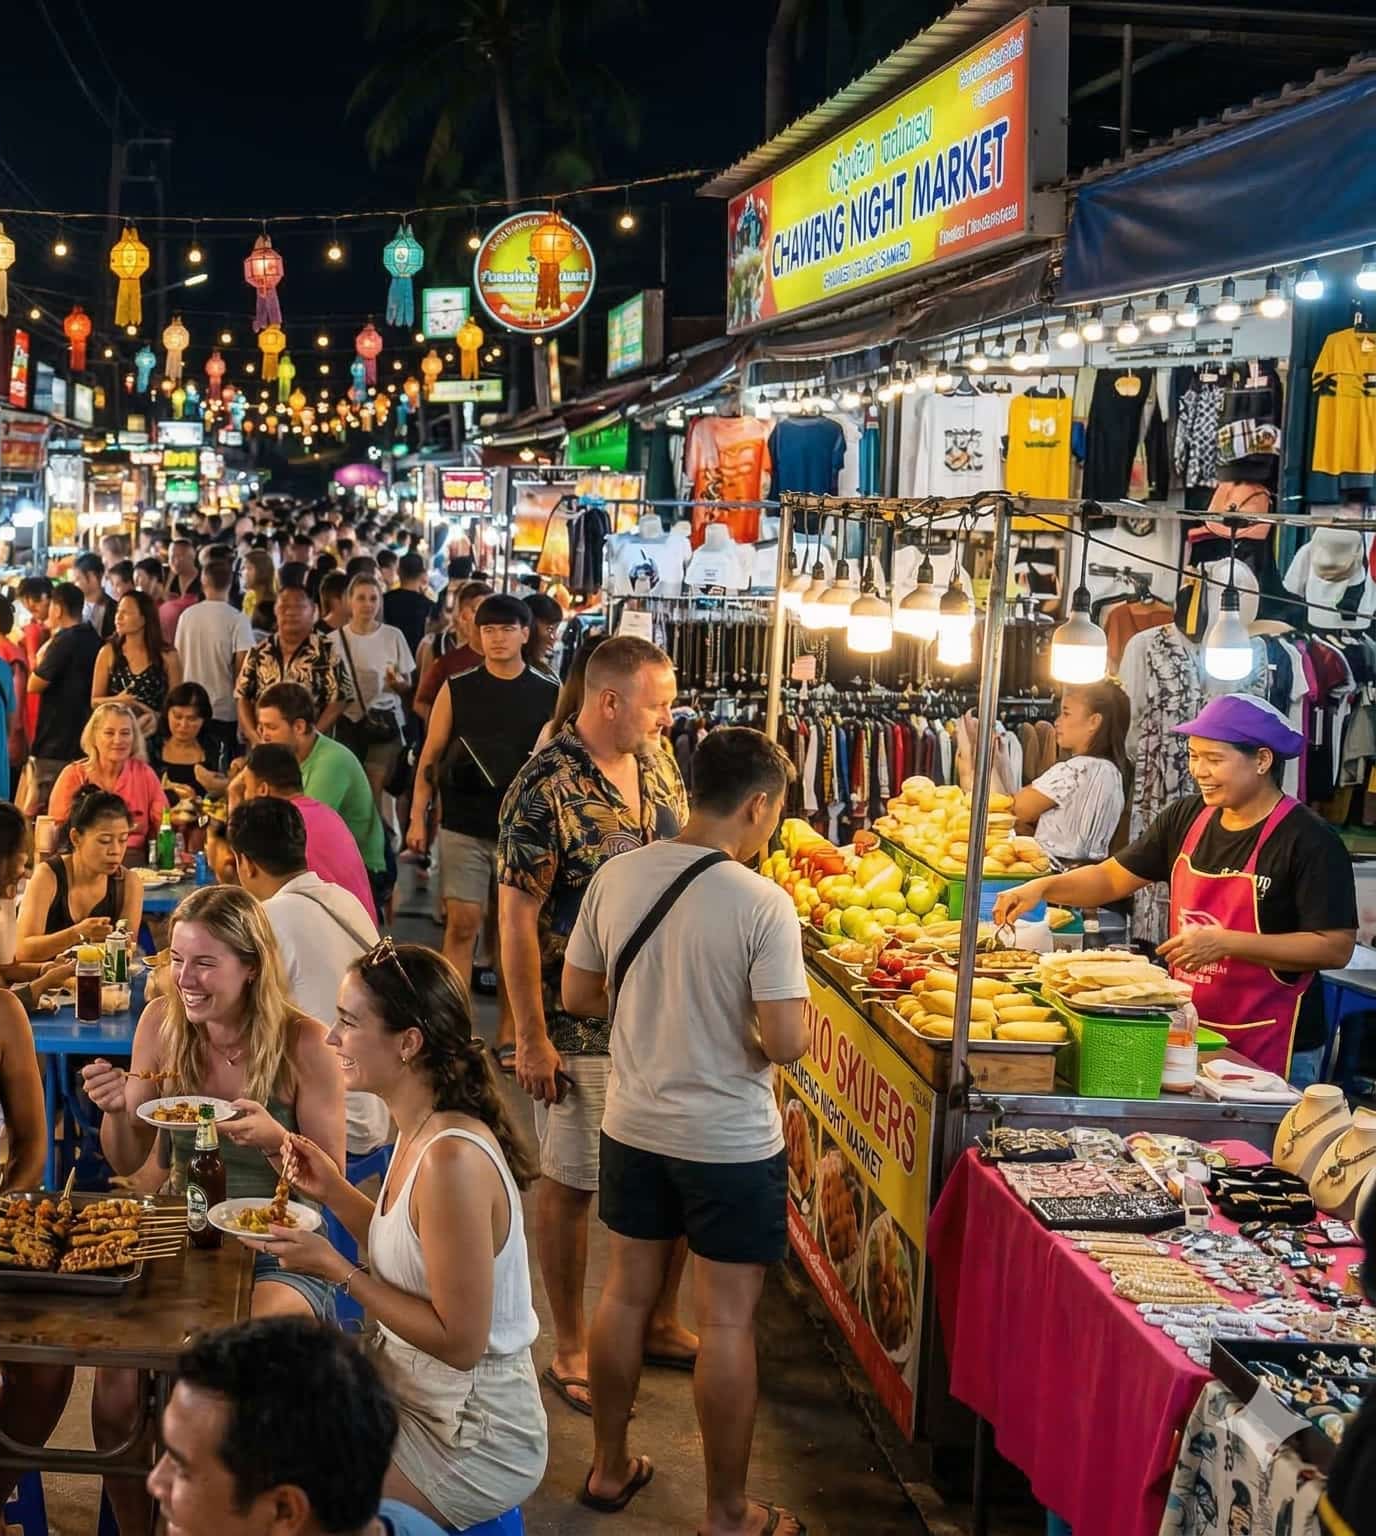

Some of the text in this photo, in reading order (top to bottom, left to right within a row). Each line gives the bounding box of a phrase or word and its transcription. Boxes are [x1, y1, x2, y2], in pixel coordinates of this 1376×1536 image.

[772, 202, 845, 279] CHAWENG
[849, 171, 907, 250] NIGHT
[912, 118, 1009, 223] MARKET
[835, 1031, 917, 1176] SKUERS
[846, 1119, 883, 1182] MARKET
